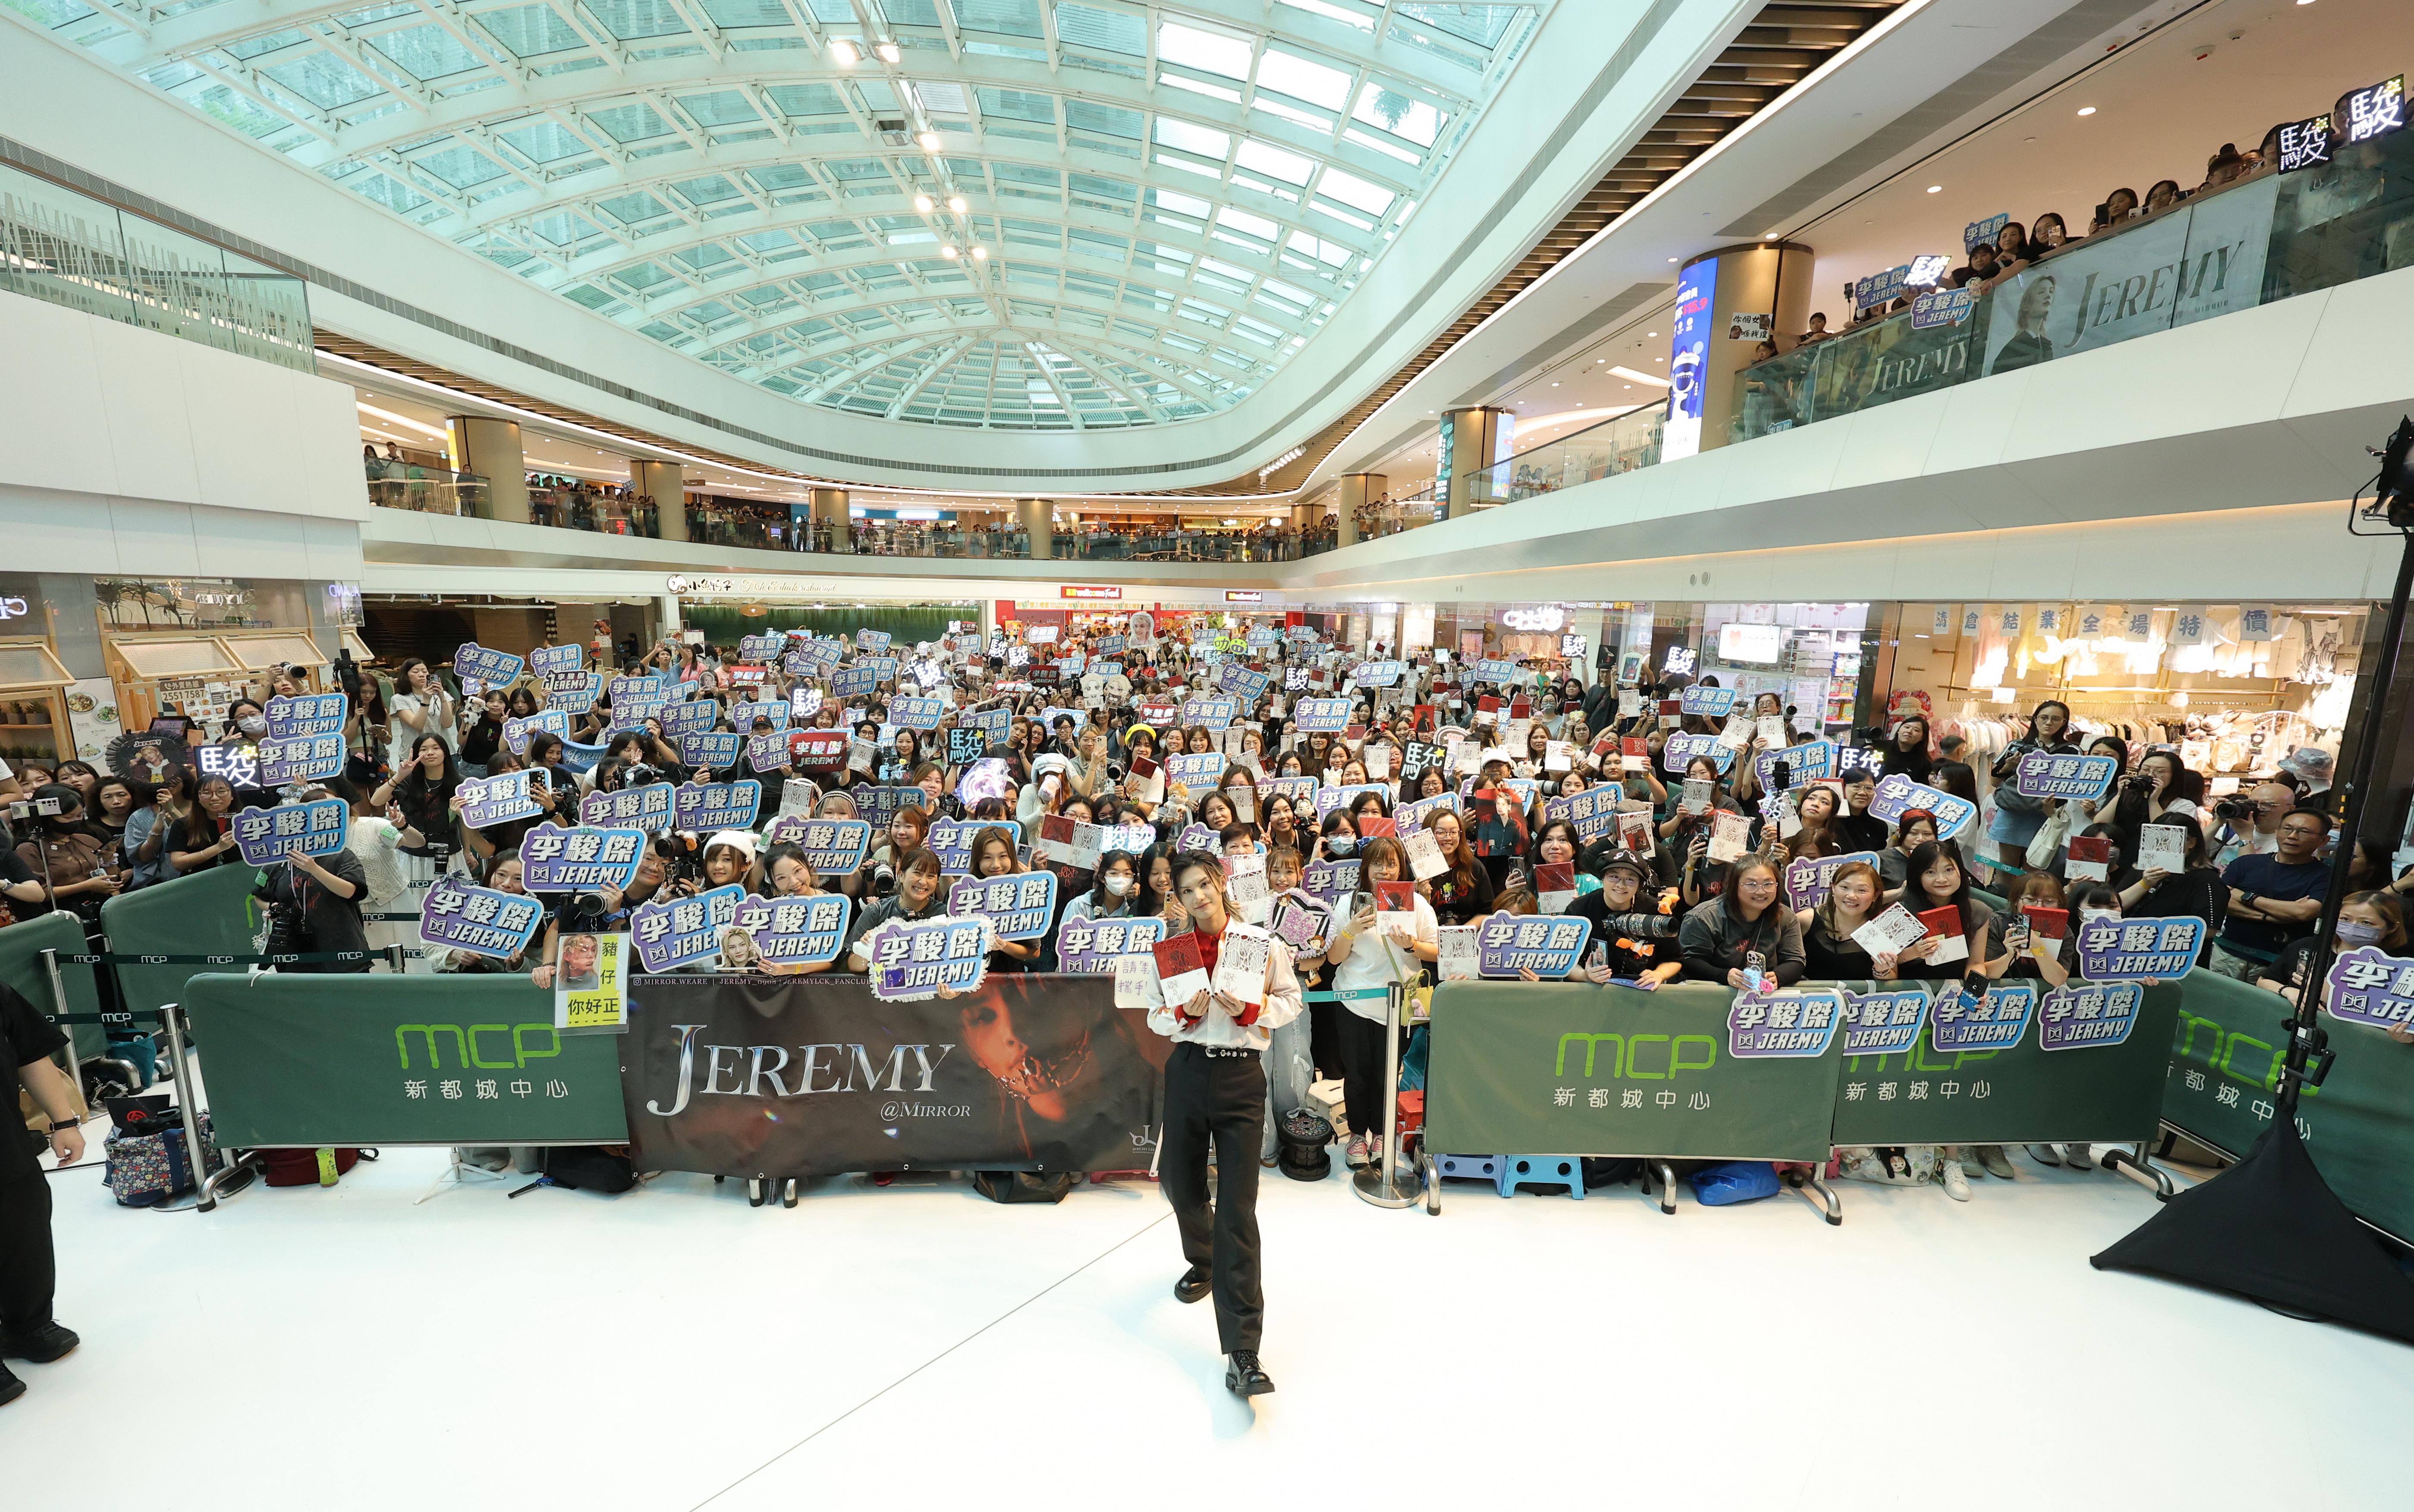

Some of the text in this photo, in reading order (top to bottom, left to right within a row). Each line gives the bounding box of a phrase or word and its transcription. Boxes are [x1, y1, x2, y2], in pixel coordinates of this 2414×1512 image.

[2350, 79, 2403, 141] 駿
[2280, 117, 2328, 170] 駿
[2066, 241, 2244, 349] JEREMY
[1927, 308, 1967, 323] JEREMY
[1867, 340, 1968, 396] JEREMY
[1077, 589, 1105, 597] wellcome
[1935, 610, 2268, 635] 清倉結業全場特價
[743, 638, 777, 649] 李駿傑
[1562, 636, 1586, 657] 駿
[460, 647, 519, 673] 李駿傑
[535, 648, 577, 665] 李駿傑
[1665, 647, 1694, 675] 駿
[470, 667, 511, 681] JEREMY
[1224, 666, 1266, 688] 李駿傑
[1360, 665, 1397, 676] 李駿傑
[1478, 663, 1512, 673] 李駿傑
[834, 670, 873, 685] 李駿傑
[1286, 668, 1309, 689] 駿
[163, 689, 205, 702] 2551 7587
[613, 680, 657, 695] 李駿傑
[846, 683, 872, 693] JEREMY
[1229, 682, 1257, 696] JEREMY
[1686, 689, 1732, 704] 李駿傑
[269, 698, 342, 721] 李駿傑
[616, 704, 665, 720] 李駿傑
[663, 703, 713, 722] 李駿傑
[893, 700, 940, 715] 李駿傑
[1187, 703, 1230, 717] 李駿傑
[1299, 703, 1348, 716] 李駿傑
[1694, 702, 1726, 713] JEREMY
[289, 721, 338, 736] JEREMY
[677, 720, 711, 732] JEREMY
[903, 715, 935, 724] JEREMY
[1196, 718, 1226, 727] JEREMY
[1310, 718, 1344, 727] JEREMY
[135, 739, 161, 747] Jeremy
[260, 737, 339, 764] 李駿傑
[686, 735, 735, 751] 李駿傑
[795, 740, 841, 755] 李駿傑
[950, 730, 985, 763] 駿
[565, 749, 603, 765] Jerem
[698, 753, 732, 763] JEREMY
[797, 756, 842, 767] JEREMY
[1169, 757, 1220, 774] 李駿傑
[283, 760, 336, 777] JEREMY
[2024, 758, 2111, 781] 李駿傑
[2040, 781, 2099, 795] JEREMY
[588, 789, 668, 822] 李駿傑
[679, 786, 754, 811] 李駿傑
[241, 806, 341, 840] 李駿傑
[700, 810, 751, 827] JEREMY
[273, 833, 338, 855] JEREMY
[528, 835, 635, 862] 李駿傑
[553, 867, 628, 884] JEREMY
[955, 879, 1047, 915] 李駿傑
[430, 885, 535, 932] 李駿傑
[640, 891, 733, 943] 李駿傑
[741, 903, 839, 934] 李駿傑
[448, 923, 519, 950] JEREMY
[1064, 923, 1157, 955] 李駿傑
[1484, 922, 1582, 949] 李駿傑
[2086, 925, 2196, 952] 李駿傑
[764, 936, 834, 957] JEREMY
[878, 928, 981, 965] 李駿傑
[600, 942, 618, 985] 豬仔
[1504, 952, 1572, 969] JEREMY
[2111, 956, 2186, 973] JEREMY
[907, 961, 974, 985] JEREMY
[568, 998, 619, 1016] 你好正
[1736, 999, 1835, 1029] 李駿傑
[2046, 990, 2137, 1022] 李駿傑
[1850, 1029, 1912, 1047] JEREMY
[1958, 1025, 2019, 1042] JEREMY
[2065, 1020, 2128, 1041] JEREMY
[1757, 1033, 1825, 1049] JEREMY
[646, 1024, 956, 1117] JEREMY
[404, 1079, 569, 1100] 新都城中心
[1553, 1087, 1710, 1110] 新都城中心
[1845, 1080, 1990, 1102] 新都城中心
[880, 1100, 971, 1121] @MIRROR
